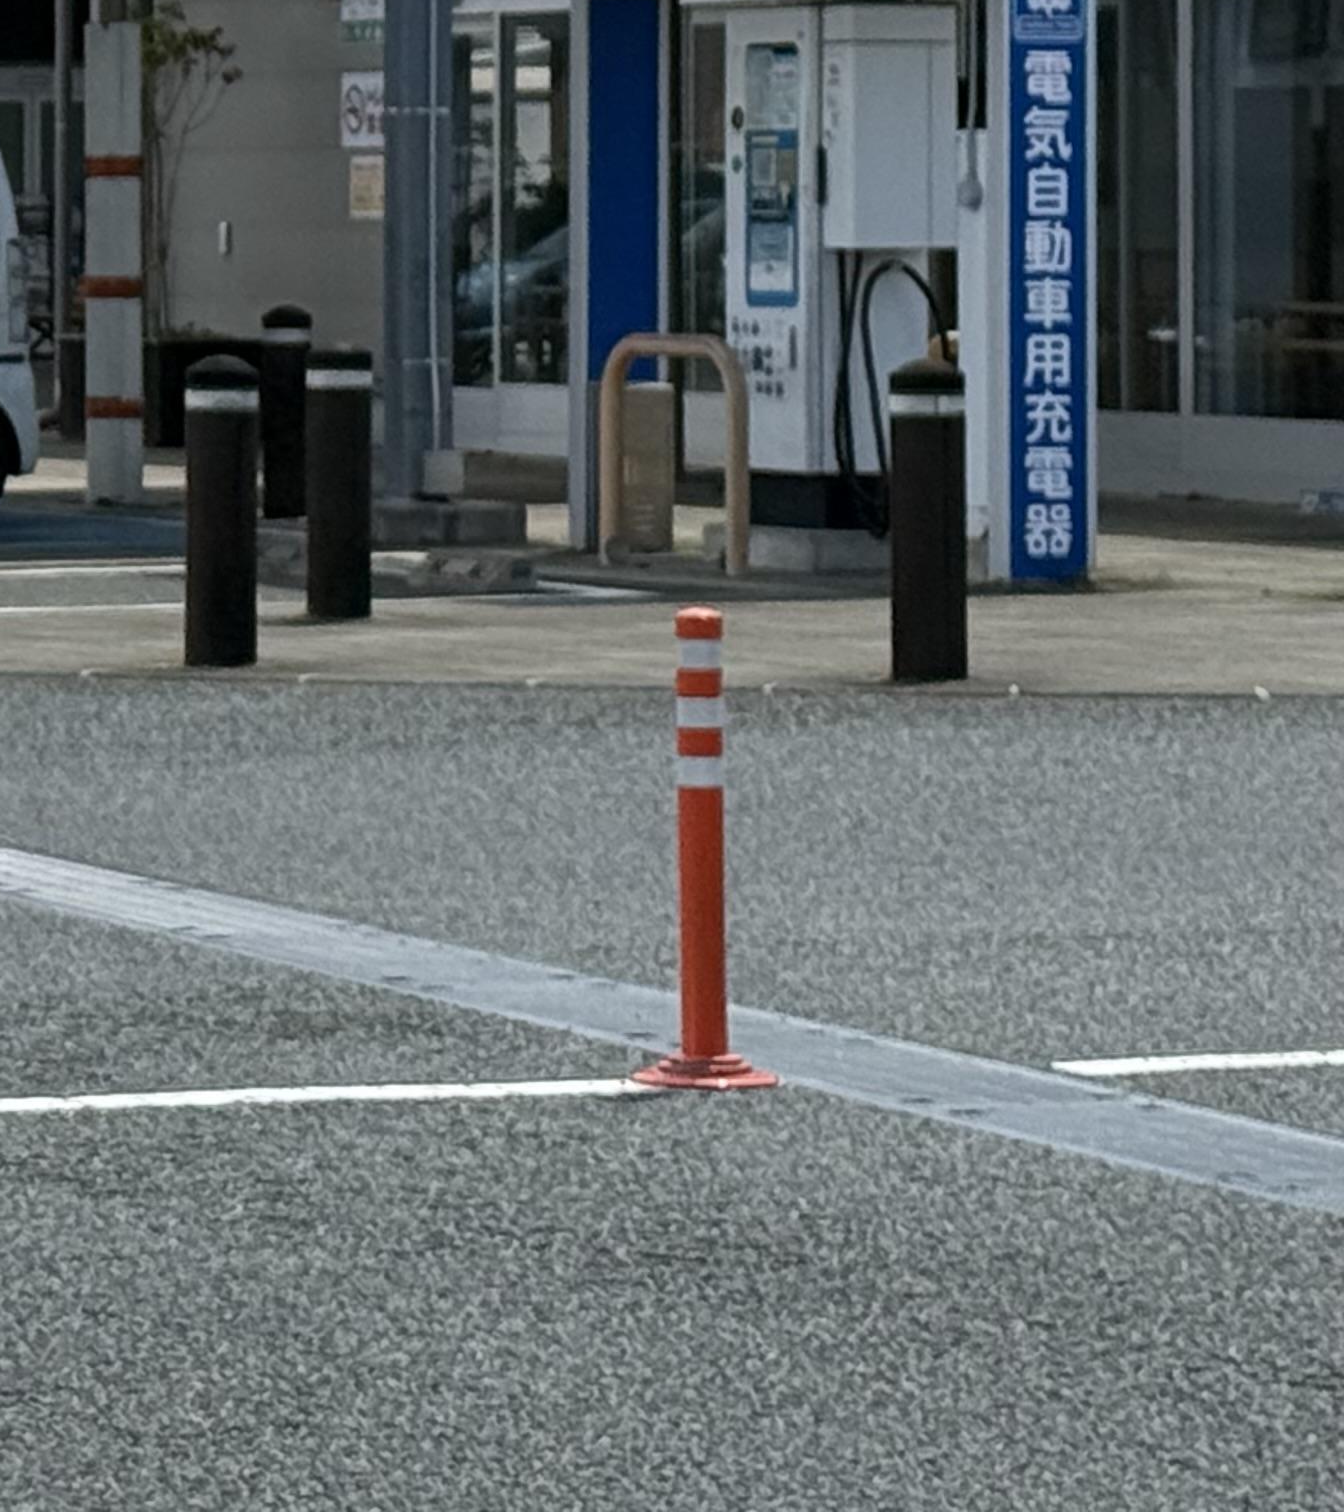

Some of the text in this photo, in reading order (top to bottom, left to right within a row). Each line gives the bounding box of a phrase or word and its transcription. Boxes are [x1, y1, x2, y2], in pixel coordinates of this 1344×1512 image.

[1023, 50, 1073, 558] 電気自動車用充電器
